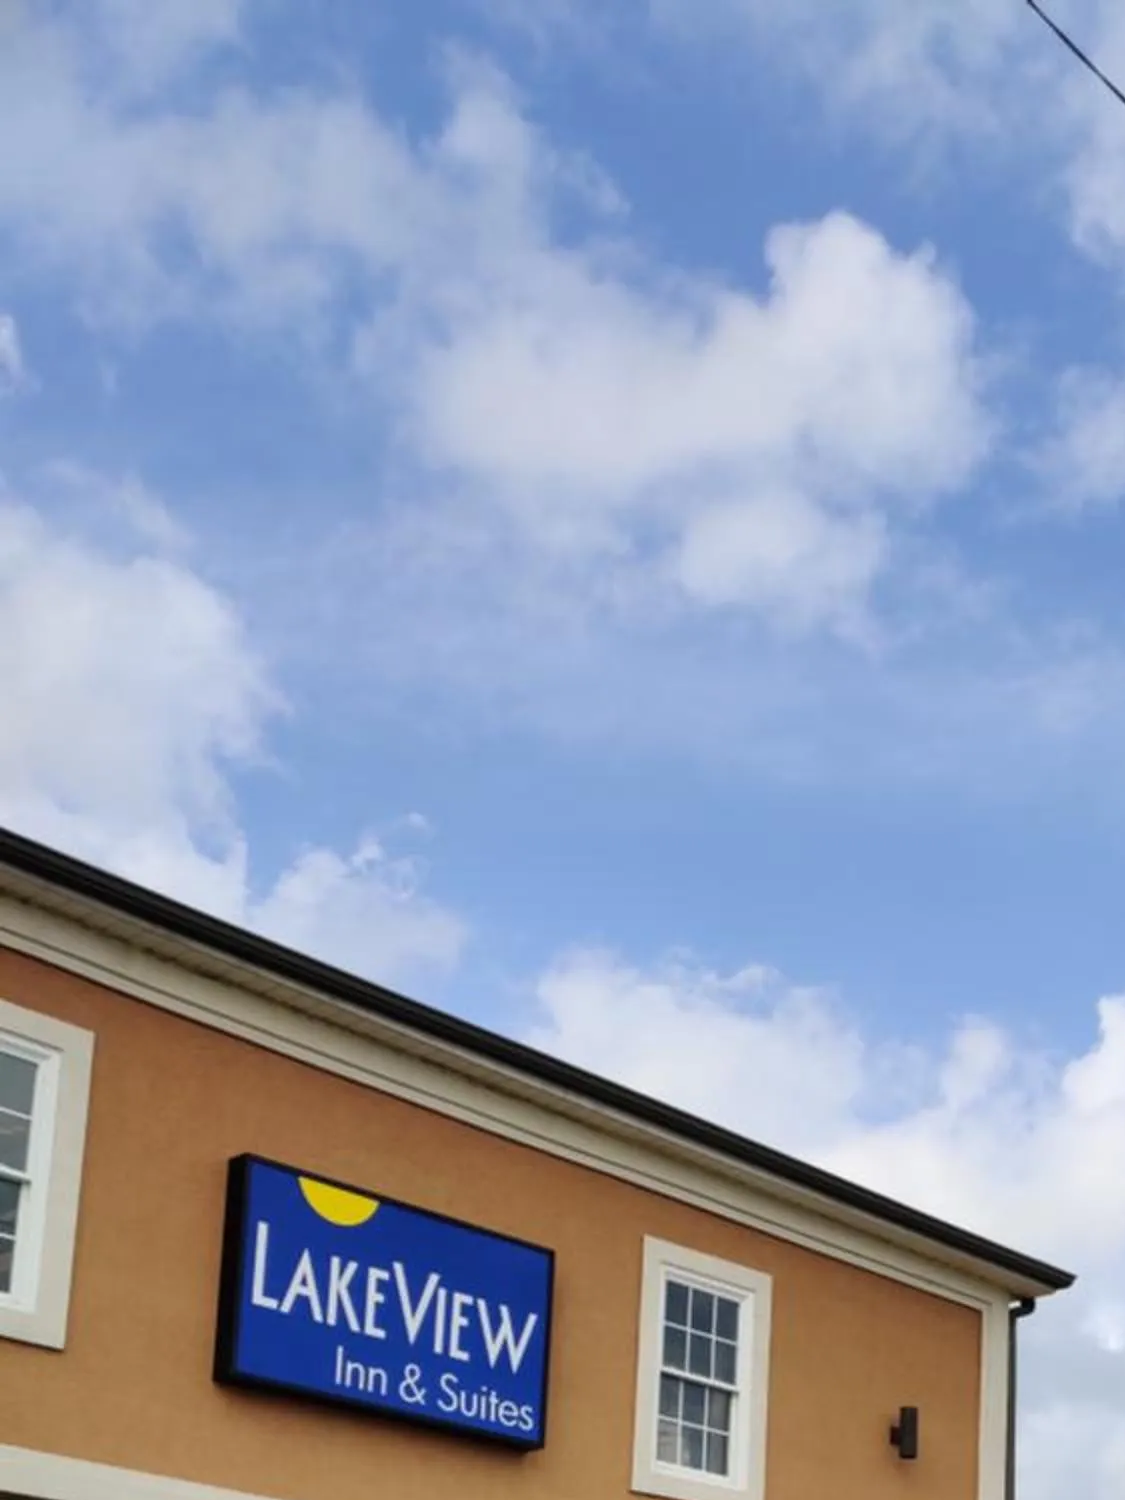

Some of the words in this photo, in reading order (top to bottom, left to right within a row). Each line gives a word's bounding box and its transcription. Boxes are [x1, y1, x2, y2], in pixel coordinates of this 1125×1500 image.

[334, 1345, 388, 1397] Inn
[399, 1363, 426, 1405] &
[437, 1373, 534, 1431] Suites
